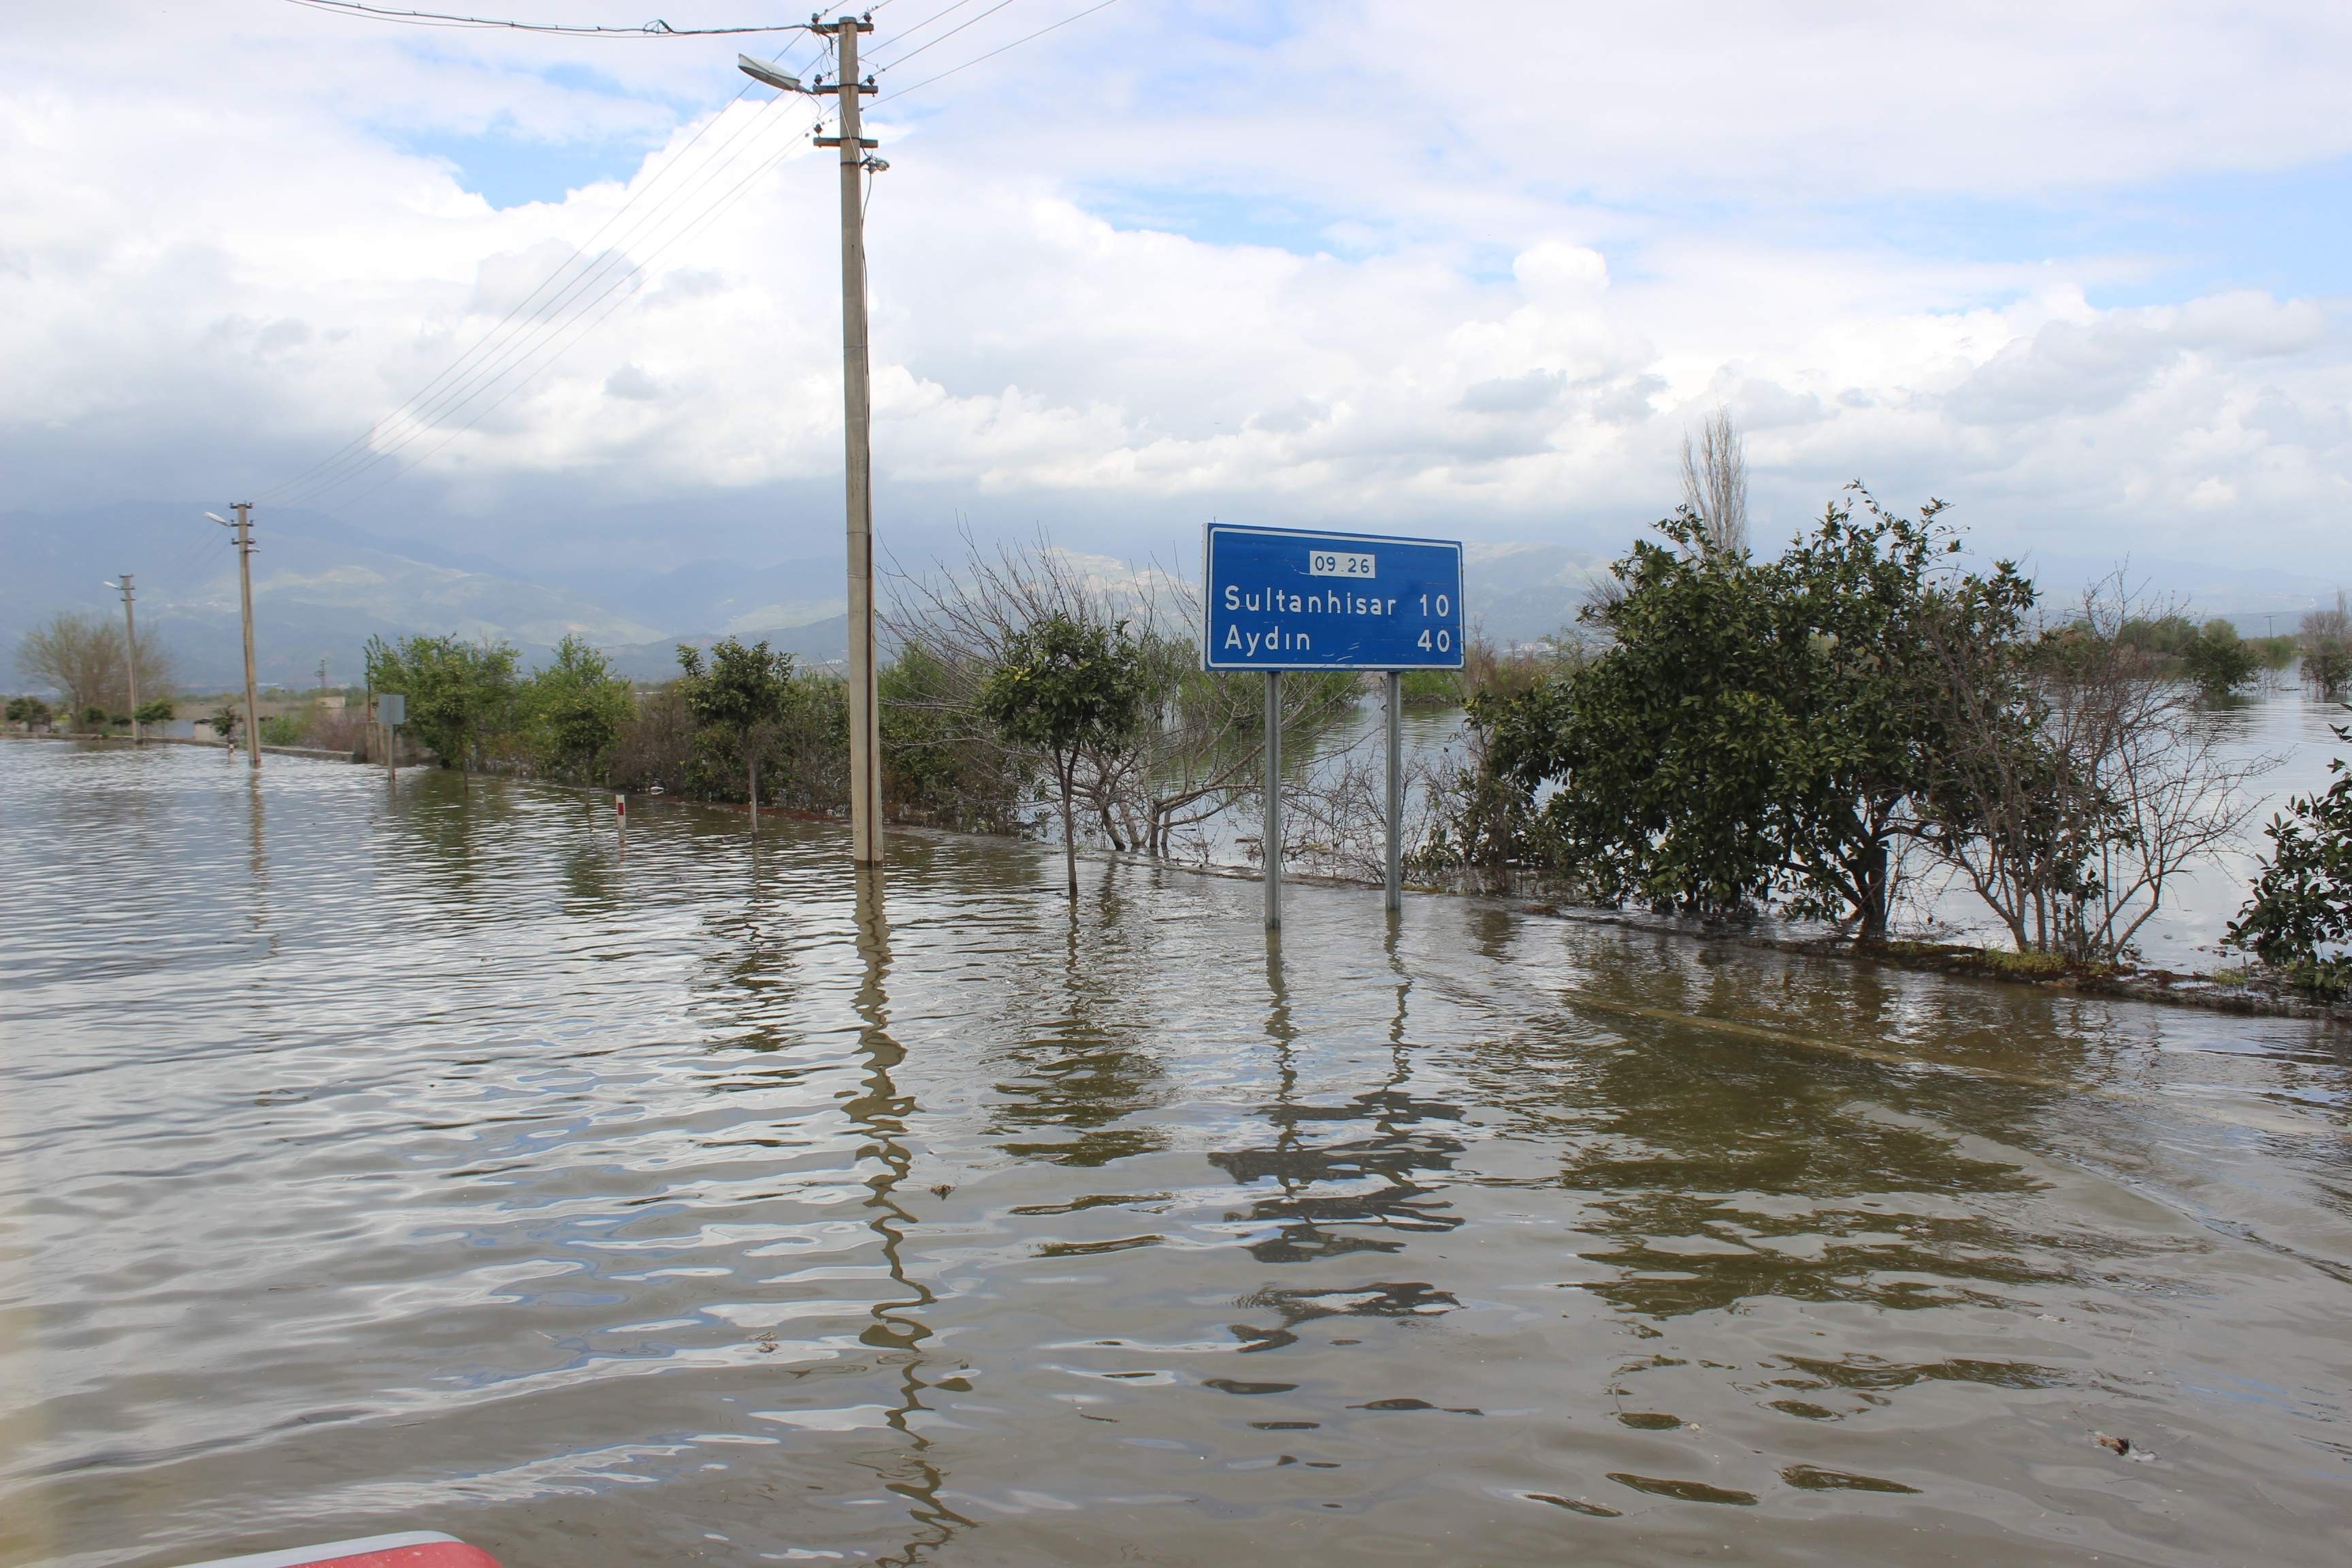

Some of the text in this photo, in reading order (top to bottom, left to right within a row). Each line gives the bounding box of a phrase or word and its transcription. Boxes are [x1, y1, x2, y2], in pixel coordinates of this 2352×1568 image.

[1225, 585, 1450, 617] Sultanhisar 10
[1224, 624, 1450, 657] Aydın 40
